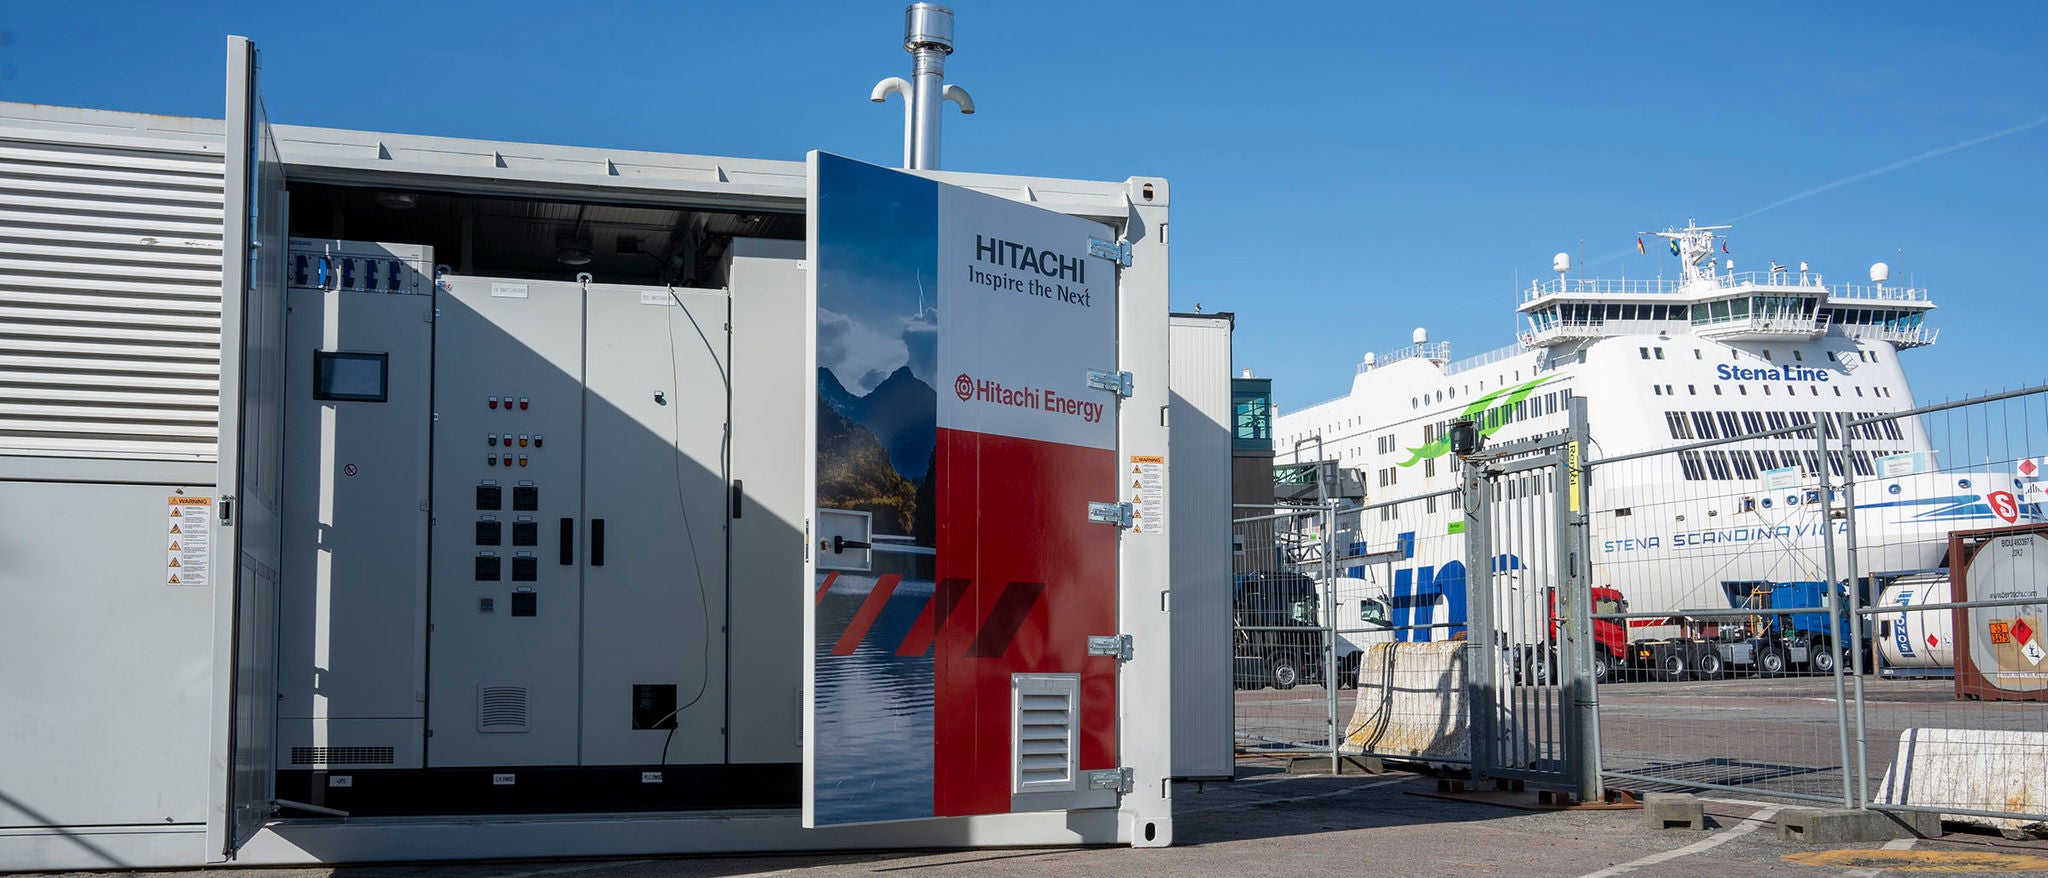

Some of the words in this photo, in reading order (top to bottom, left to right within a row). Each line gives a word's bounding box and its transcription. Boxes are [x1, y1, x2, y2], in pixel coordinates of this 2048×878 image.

[976, 234, 1085, 284] HITACHI
[968, 265, 1023, 291] Inspire
[1028, 279, 1052, 299] the
[1056, 284, 1091, 307] Next
[1717, 363, 1780, 381] Stena
[1783, 364, 1829, 382] Line
[977, 379, 1039, 409] Hitachi
[1044, 390, 1104, 423] Energy
[1604, 536, 1660, 552] STENA
